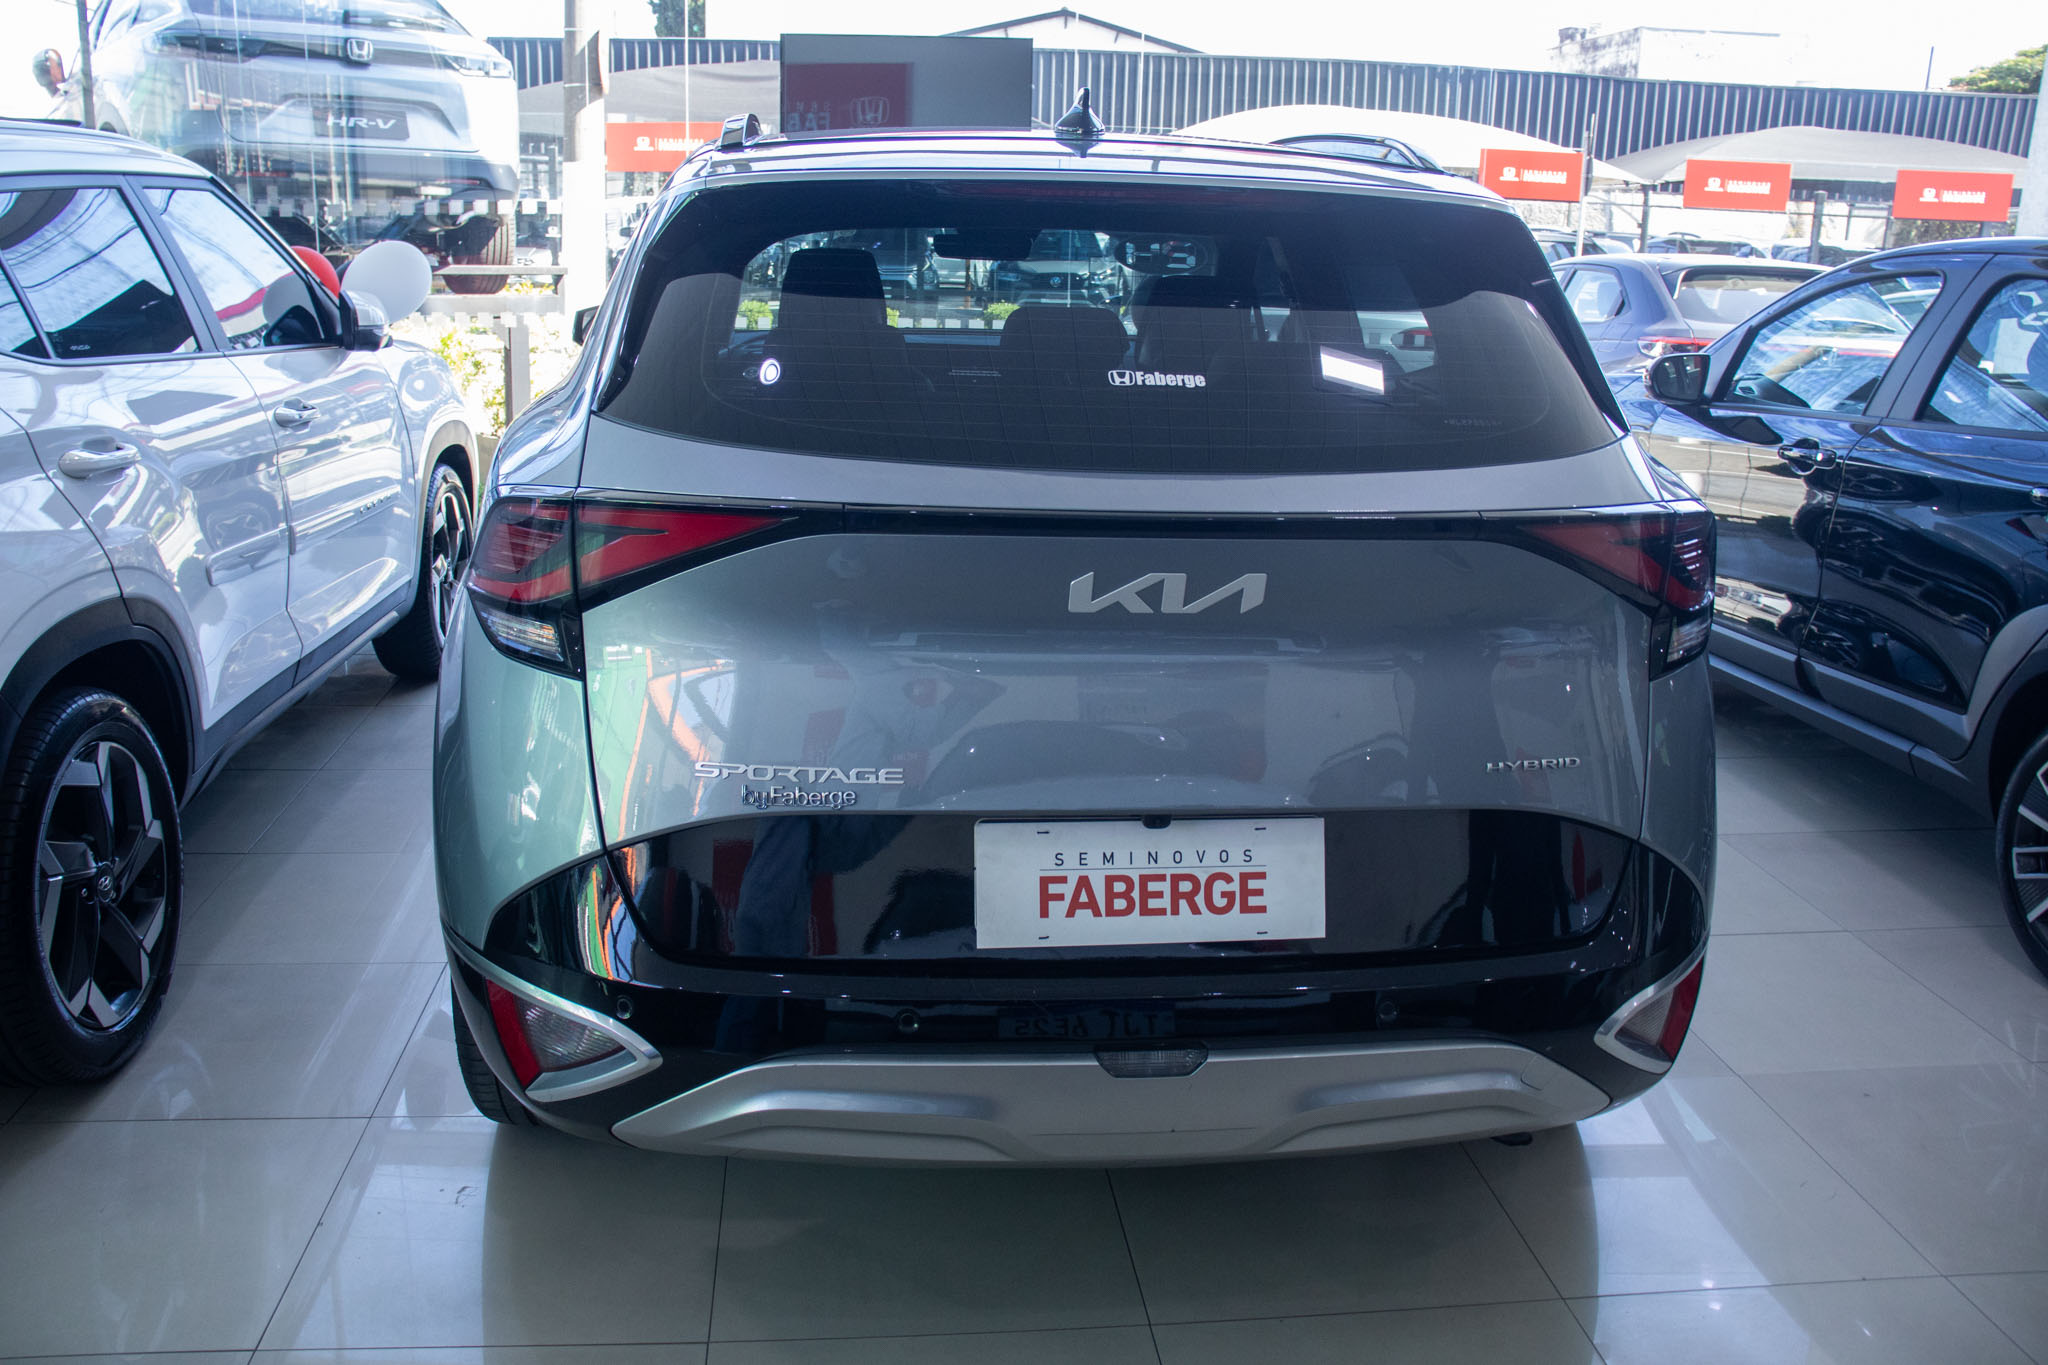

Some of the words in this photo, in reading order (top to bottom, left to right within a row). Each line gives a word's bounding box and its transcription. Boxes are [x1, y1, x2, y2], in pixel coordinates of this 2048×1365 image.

[326, 115, 397, 129] HR-V
[1135, 371, 1206, 388] Faberge
[1068, 571, 1267, 614] KIA
[694, 761, 904, 785] SPORTAGE
[1486, 757, 1581, 773] HYBRID
[1054, 849, 1253, 867] SEMINOVOS
[1039, 871, 1268, 919] FABERGE
